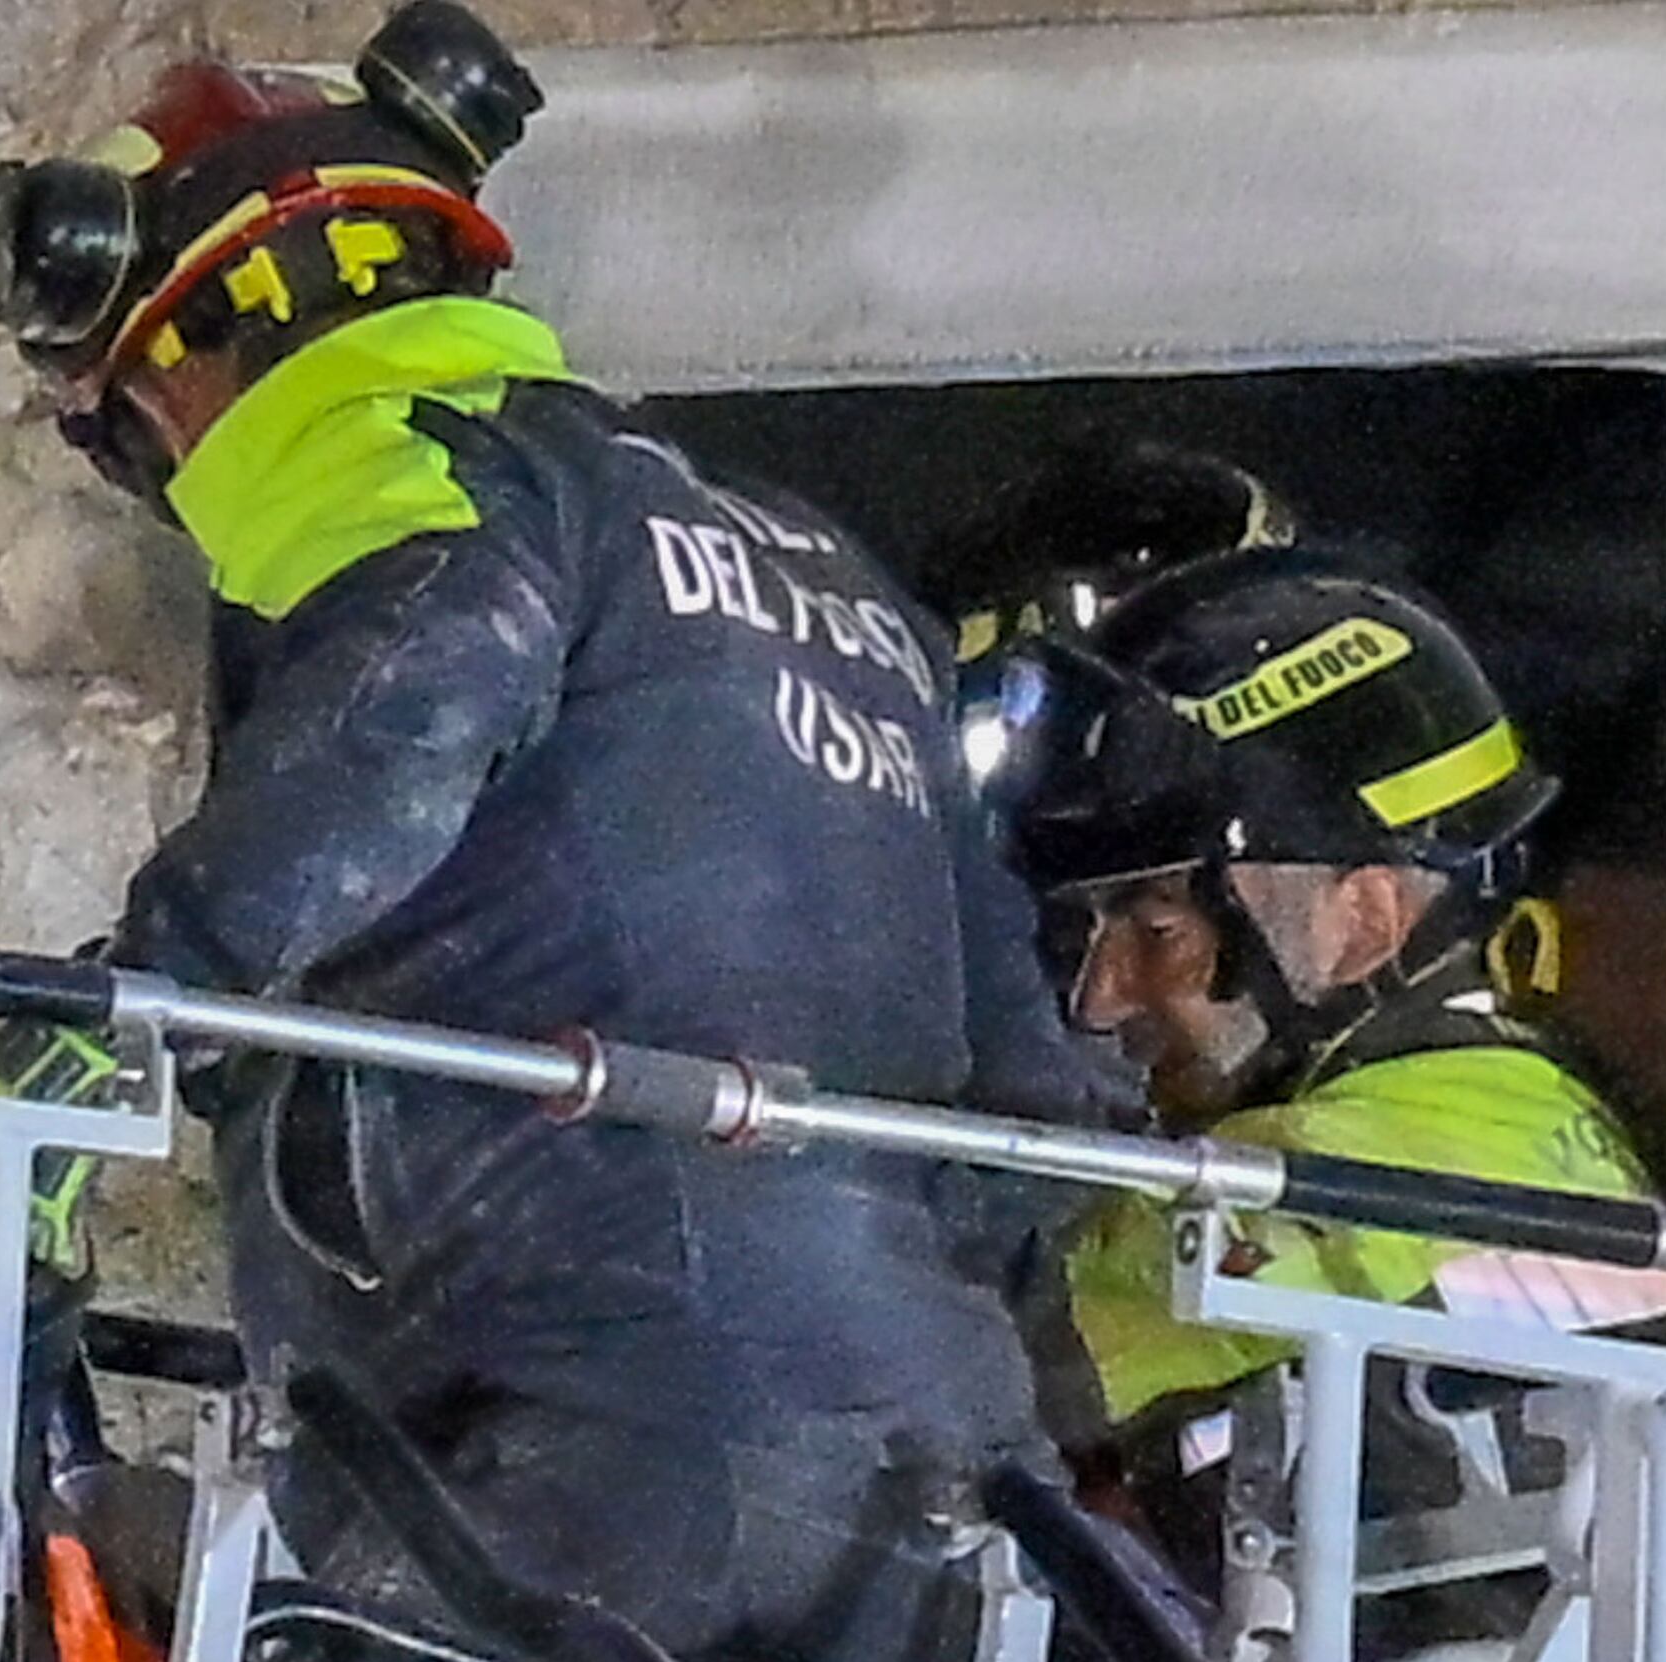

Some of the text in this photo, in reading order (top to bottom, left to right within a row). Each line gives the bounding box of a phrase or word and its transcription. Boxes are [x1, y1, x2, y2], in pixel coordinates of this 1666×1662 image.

[645, 515, 779, 633] DEL
[1217, 681, 1282, 728] DEL
[1280, 631, 1382, 700] FUOCO
[775, 666, 931, 818] USAR
